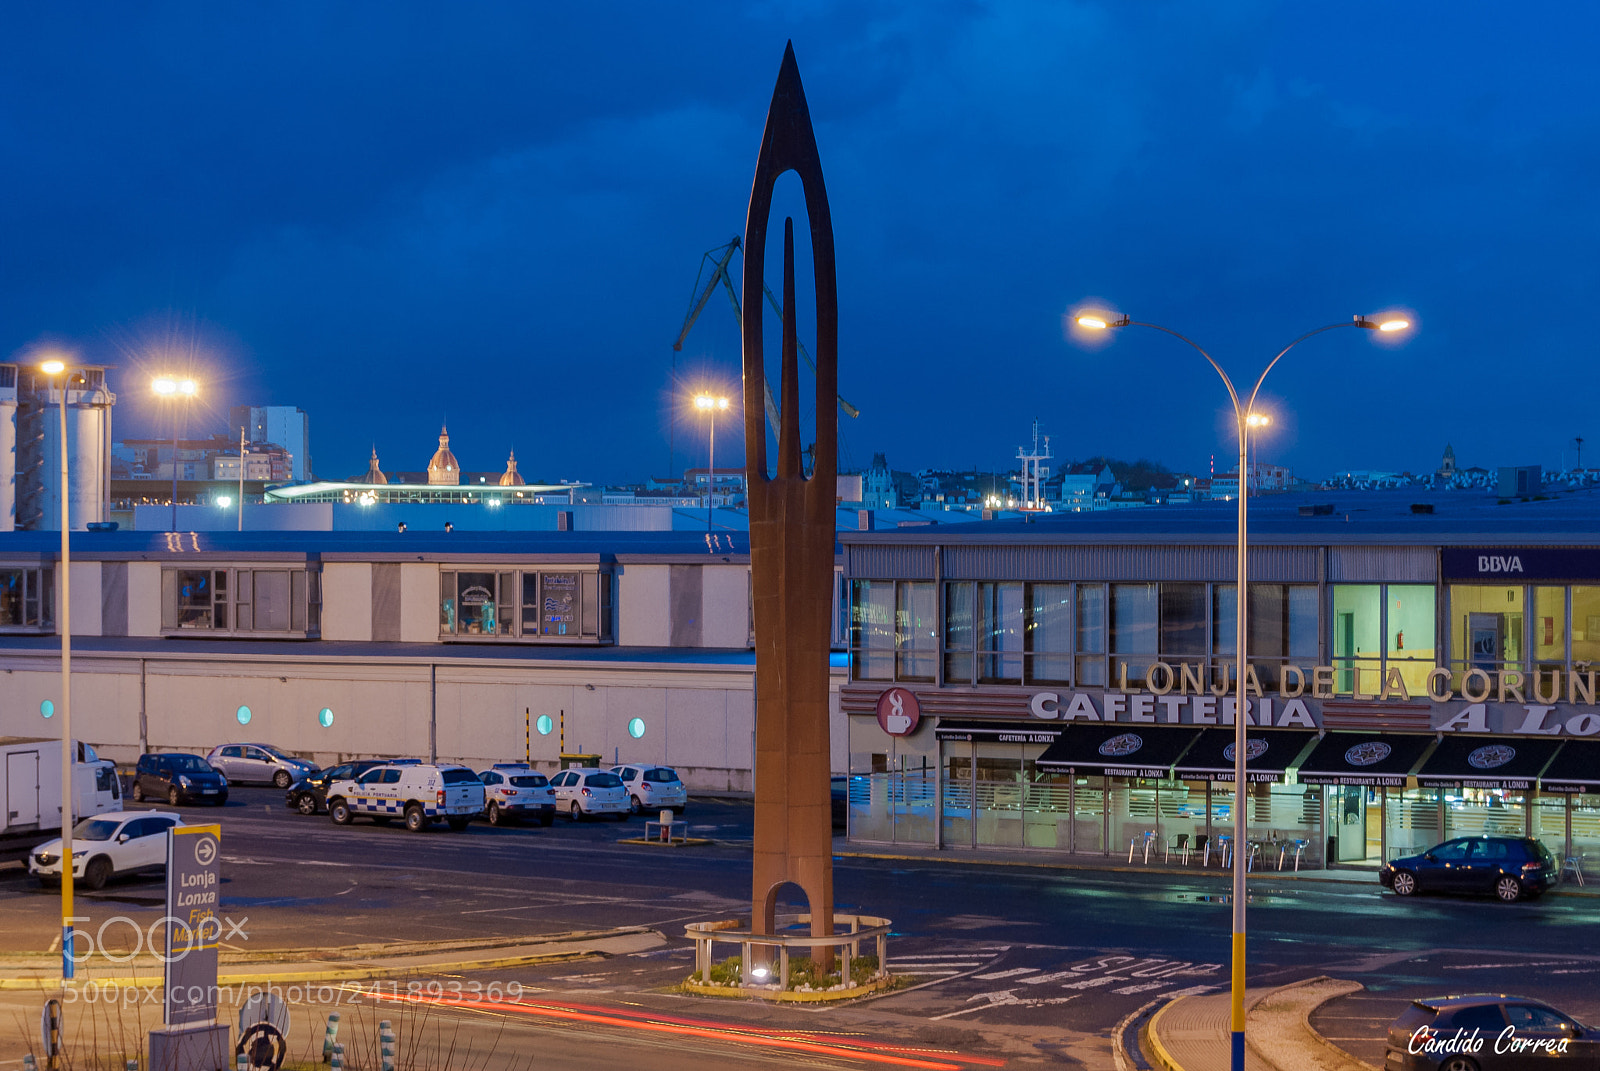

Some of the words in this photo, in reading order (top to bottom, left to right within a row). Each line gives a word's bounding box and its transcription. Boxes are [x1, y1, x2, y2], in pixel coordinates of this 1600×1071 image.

[1478, 556, 1523, 572] BBVA
[1120, 661, 1264, 698] LONJA
[1279, 664, 1335, 699] DE
[1352, 666, 1411, 701] LA
[1031, 692, 1316, 728] CAFETERIA
[1435, 703, 1491, 732] A
[181, 870, 216, 888] Lonja
[177, 891, 216, 907] Lonxa
[188, 908, 214, 924] Fish
[173, 925, 214, 942] Market
